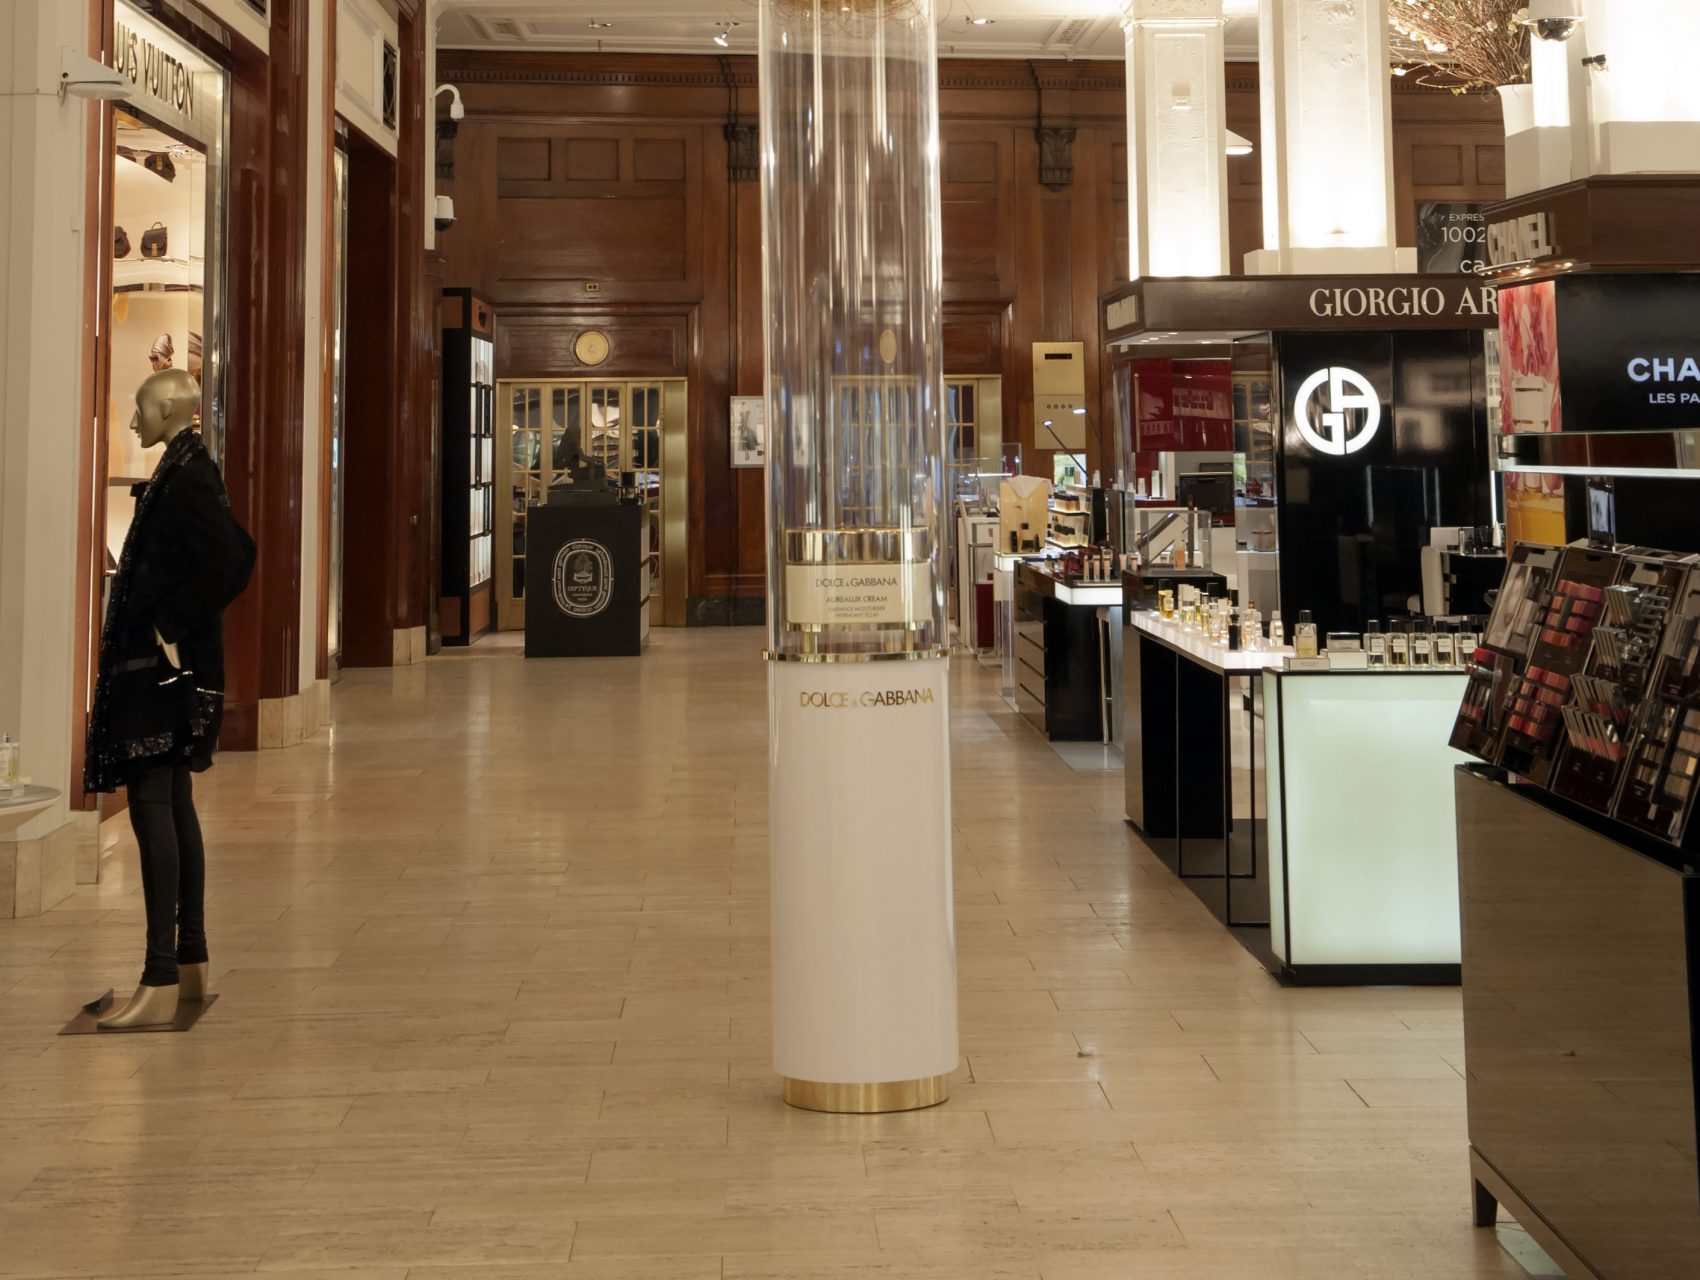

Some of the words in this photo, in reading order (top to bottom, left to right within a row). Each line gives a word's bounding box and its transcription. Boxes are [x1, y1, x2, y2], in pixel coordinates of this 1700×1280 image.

[142, 37, 195, 121] VUITTON
[1487, 212, 1553, 266] CHANEL
[1309, 287, 1445, 317] GIORGIO
[1627, 357, 1700, 382] CHA
[1649, 393, 1676, 404] LES
[815, 578, 846, 588] DOLCE
[850, 577, 898, 587] GABBANA
[862, 595, 888, 603] CREAM
[800, 691, 849, 708] DOLCE
[859, 687, 934, 707] GABBANA
